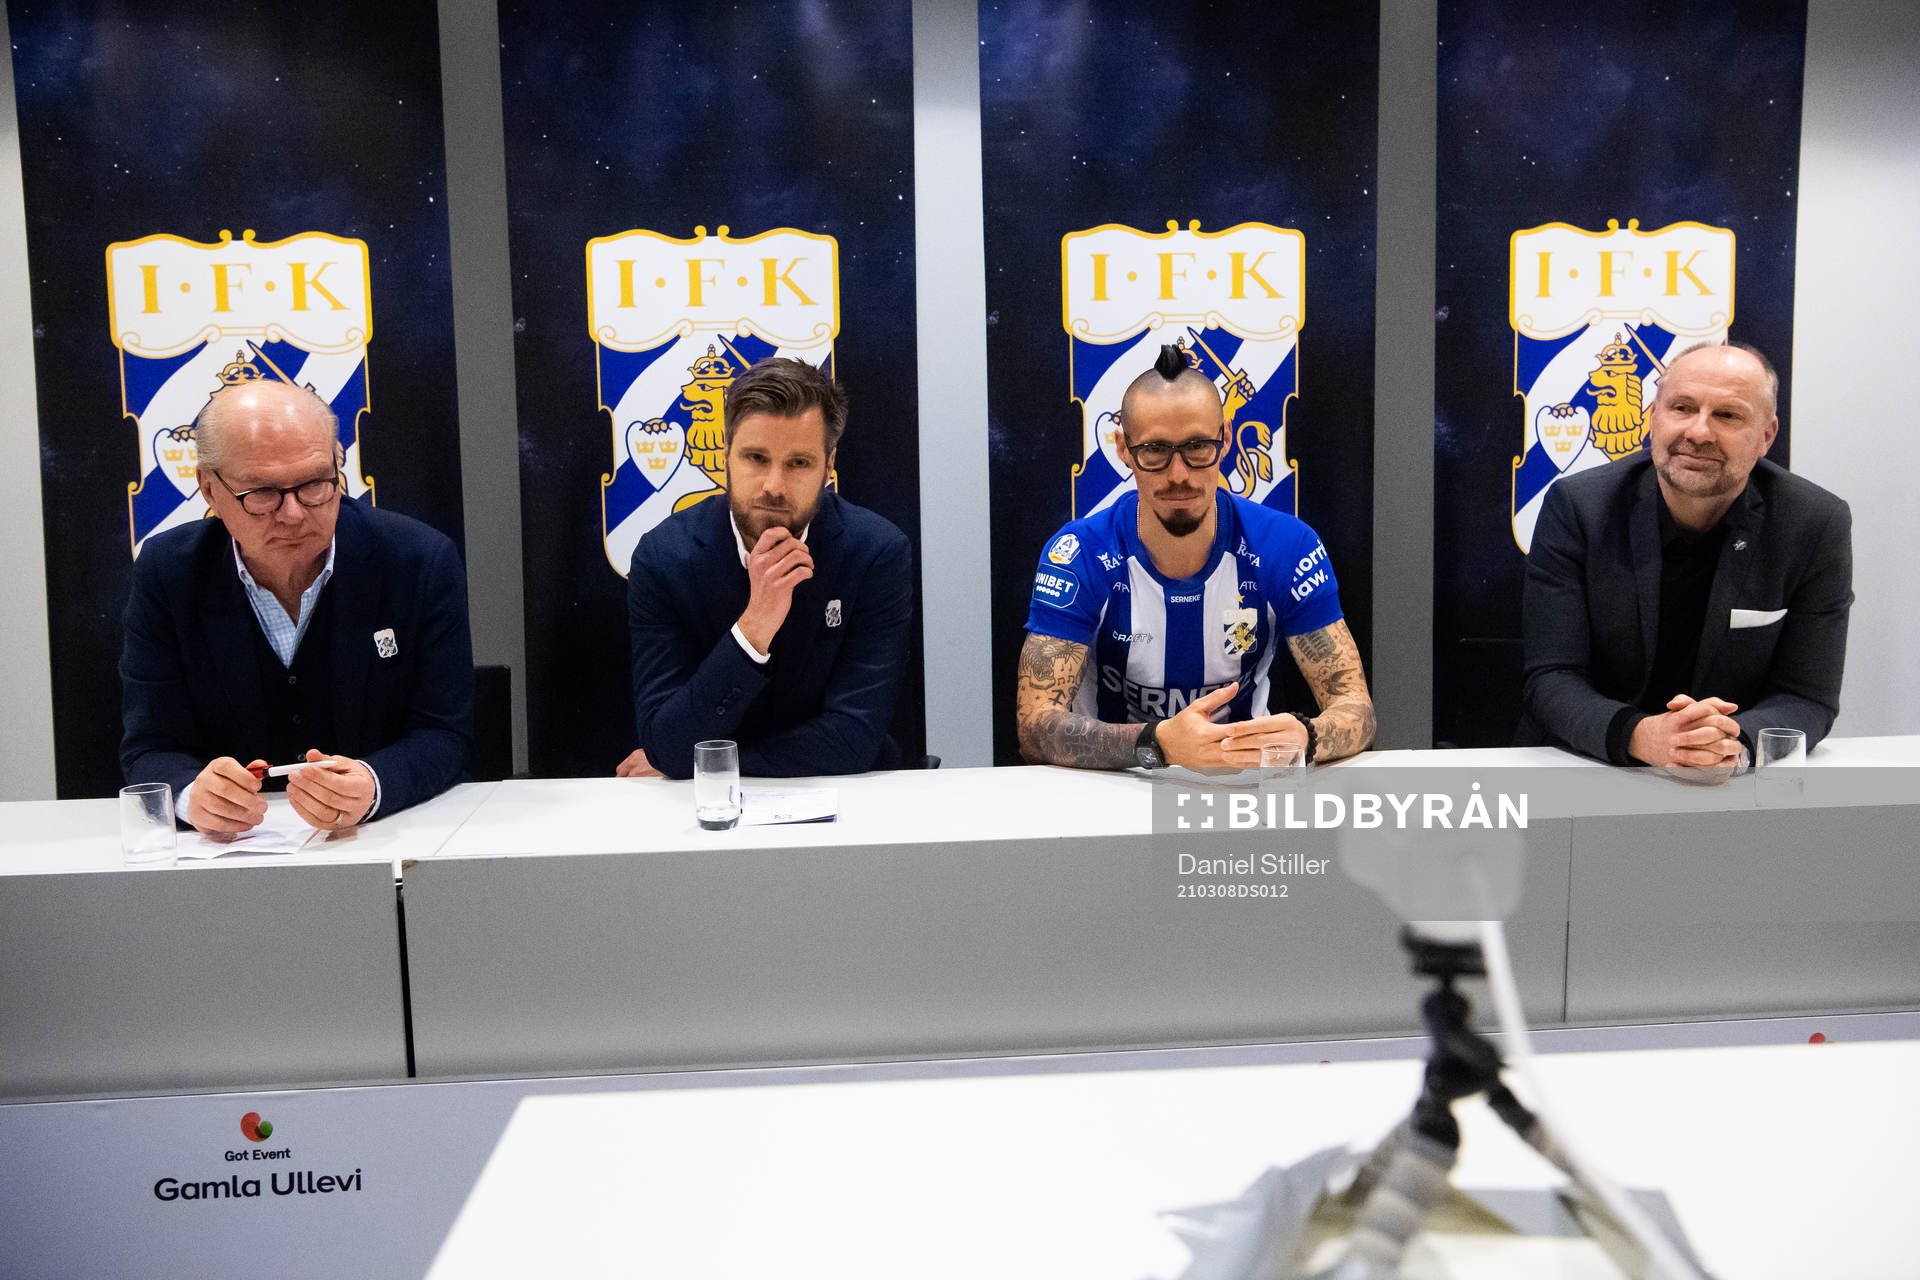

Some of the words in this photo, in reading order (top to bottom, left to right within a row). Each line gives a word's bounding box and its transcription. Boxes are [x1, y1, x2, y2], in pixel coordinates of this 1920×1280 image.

[1170, 594, 1201, 603] SERNEKE
[1112, 630, 1148, 643] CRAFT
[224, 1150, 249, 1162] Got
[253, 1148, 291, 1161] Event
[154, 1175, 261, 1201] Gamla
[271, 1168, 362, 1195] Ullevi
